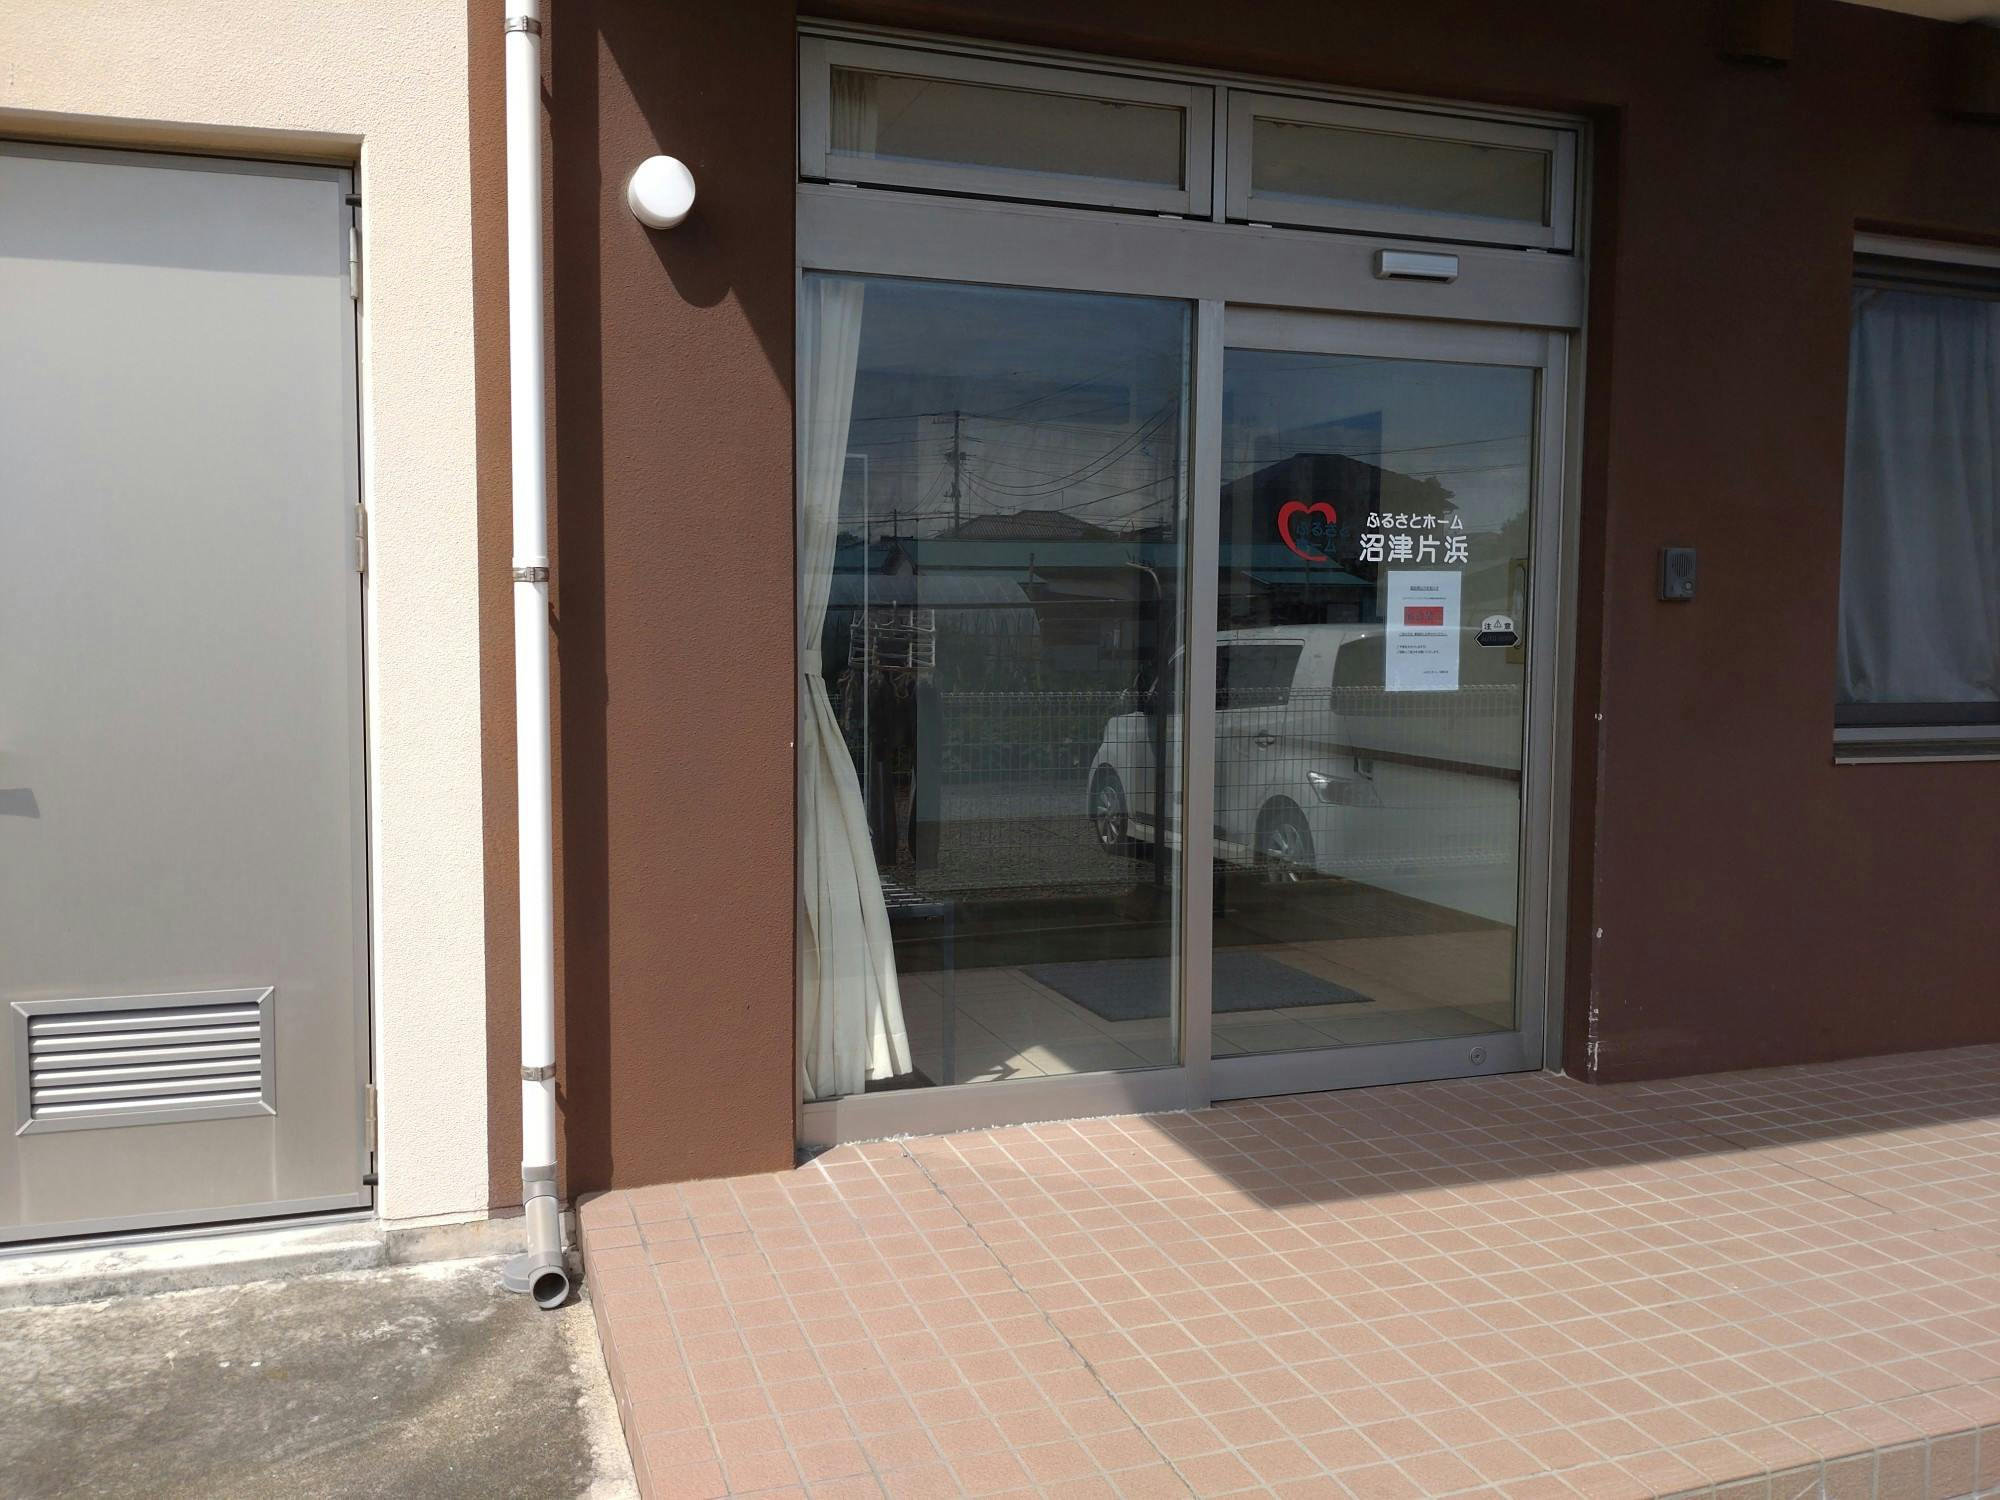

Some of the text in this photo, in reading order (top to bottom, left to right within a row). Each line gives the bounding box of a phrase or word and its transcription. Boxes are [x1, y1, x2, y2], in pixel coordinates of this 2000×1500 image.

[1366, 512, 1463, 530] ふるさとホーム
[1359, 533, 1469, 564] 沼津片浜
